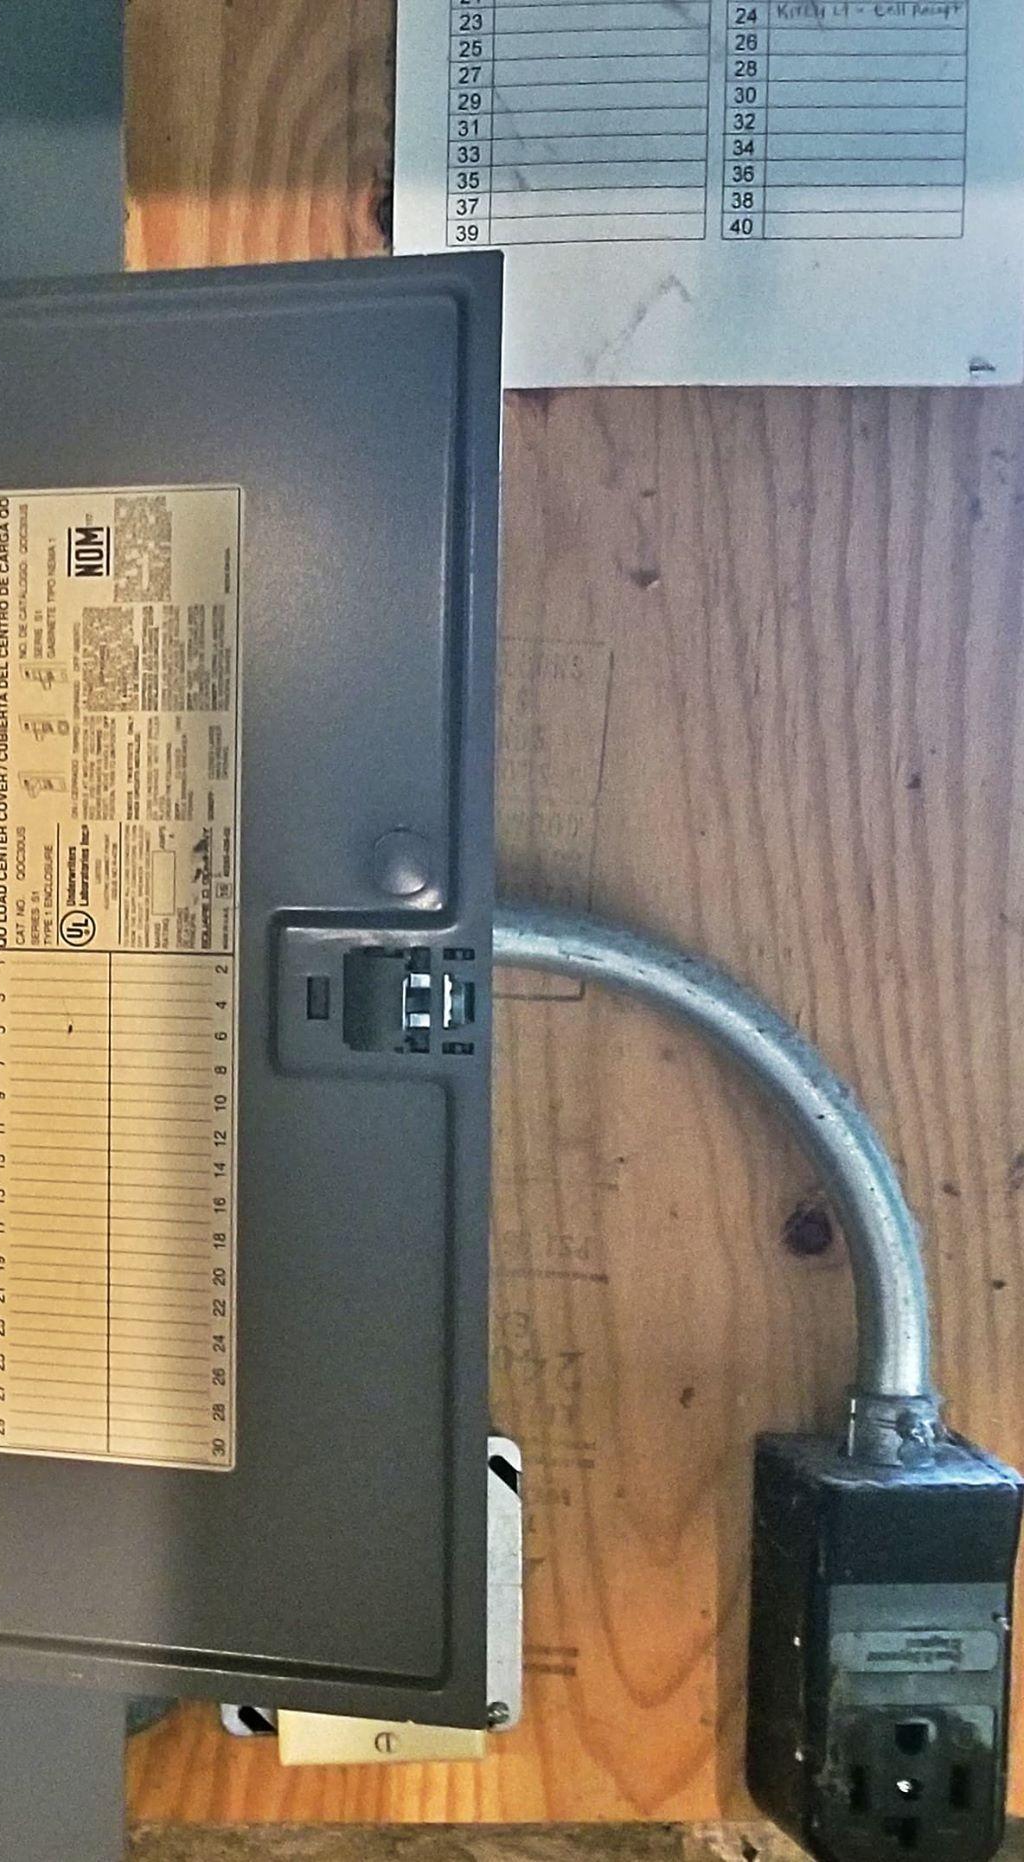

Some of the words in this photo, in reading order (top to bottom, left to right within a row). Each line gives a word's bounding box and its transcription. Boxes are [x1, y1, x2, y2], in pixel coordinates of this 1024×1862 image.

[459, 14, 482, 31] 23
[735, 8, 757, 24] 24
[459, 41, 482, 57] 25
[735, 34, 757, 51] 26
[458, 67, 482, 84] 27
[734, 61, 757, 77] 28
[458, 94, 481, 110] 29
[734, 87, 757, 103] 30
[458, 120, 481, 136] 31
[734, 114, 756, 130] 32
[458, 147, 480, 163] 33
[733, 140, 755, 156] 34
[457, 173, 479, 189] 35
[732, 166, 755, 182] 36
[457, 199, 479, 215] 37
[732, 193, 754, 209] 38
[456, 225, 479, 242] 39
[730, 219, 753, 235] 40
[74, 526, 104, 577] NOM
[47, 580, 56, 602] TIPO
[47, 607, 56, 659] GABINETE
[44, 845, 53, 908] ENCLOSURE
[31, 908, 40, 946] SERIES
[44, 920, 53, 946] TYPE
[66, 918, 89, 939] UL
[215, 965, 228, 974] 2
[215, 1001, 228, 1010] 4
[215, 1032, 227, 1041] 6
[215, 1066, 227, 1075] 8
[215, 1095, 227, 1111] 10
[214, 1130, 226, 1147] 12
[214, 1162, 226, 1177] 14
[214, 1197, 226, 1214] 16
[214, 1233, 226, 1249] 18
[213, 1268, 226, 1286] 20
[213, 1299, 226, 1317] 22
[213, 1335, 225, 1352] 24
[213, 1368, 225, 1386] 26
[213, 1404, 225, 1421] 28
[213, 1438, 225, 1456] 30
